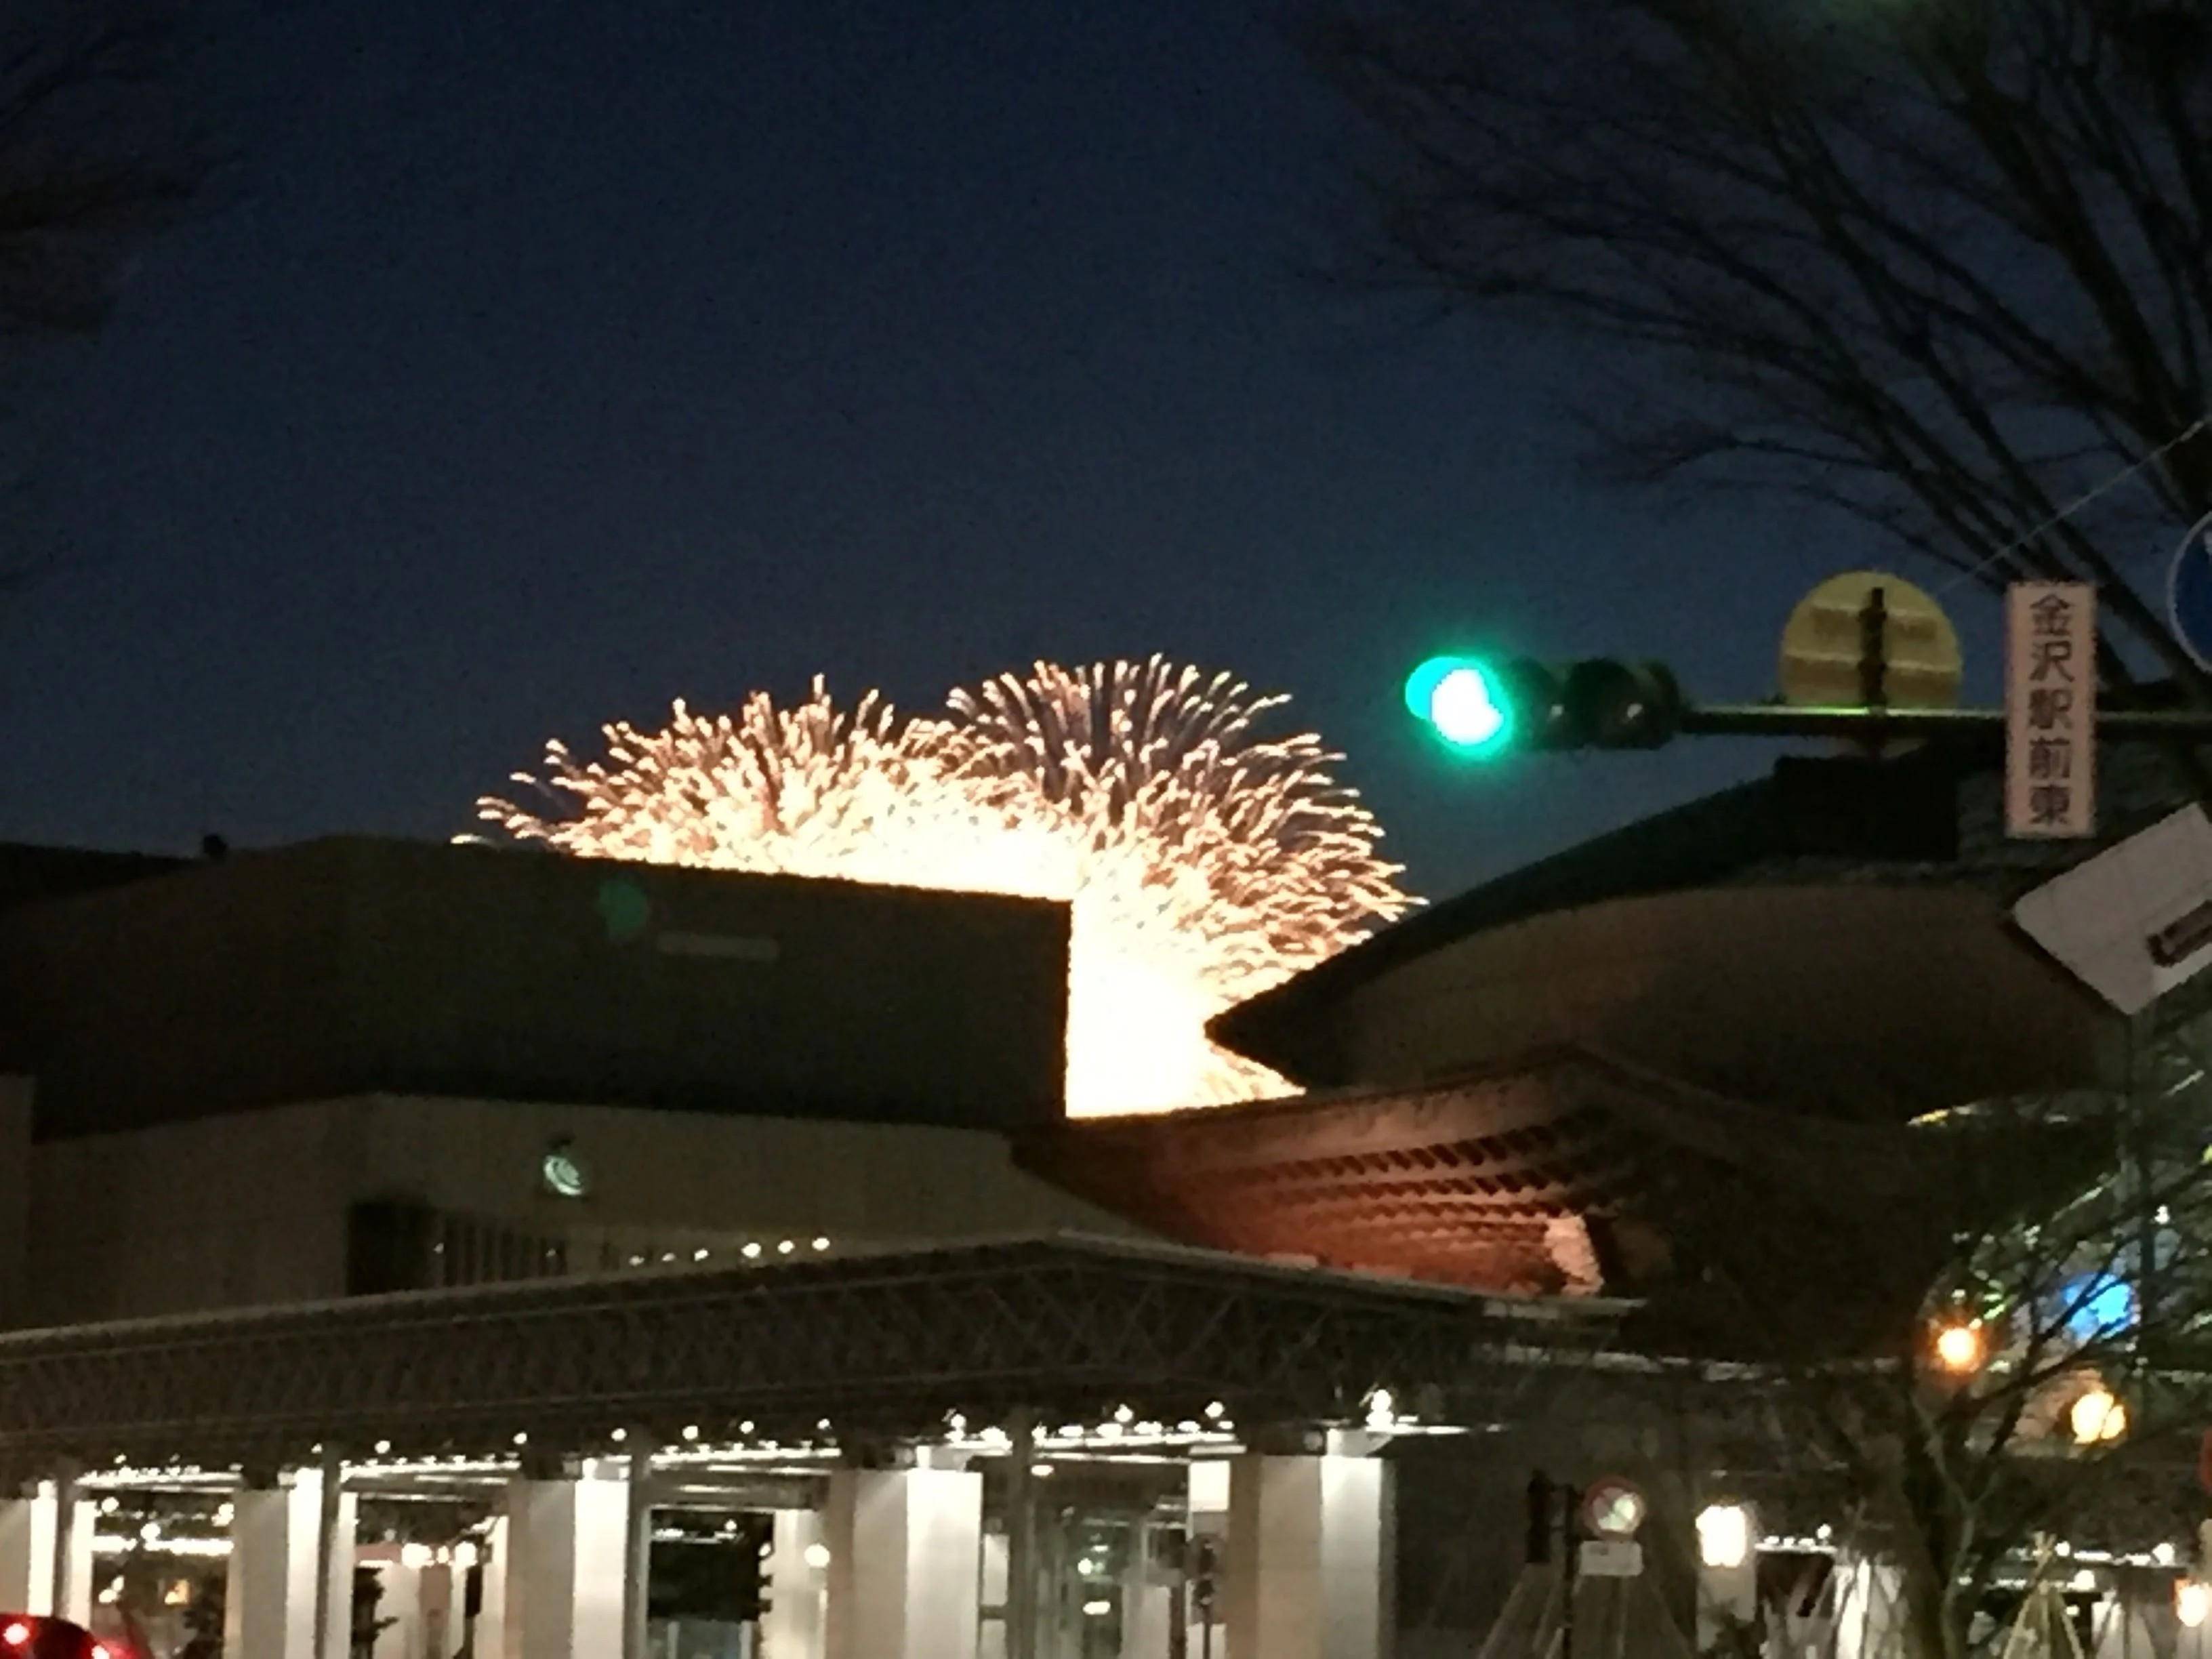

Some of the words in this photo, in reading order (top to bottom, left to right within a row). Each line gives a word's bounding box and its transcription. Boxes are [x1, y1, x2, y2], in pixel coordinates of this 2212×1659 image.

[2029, 593, 2074, 826] 金沢駅前東
